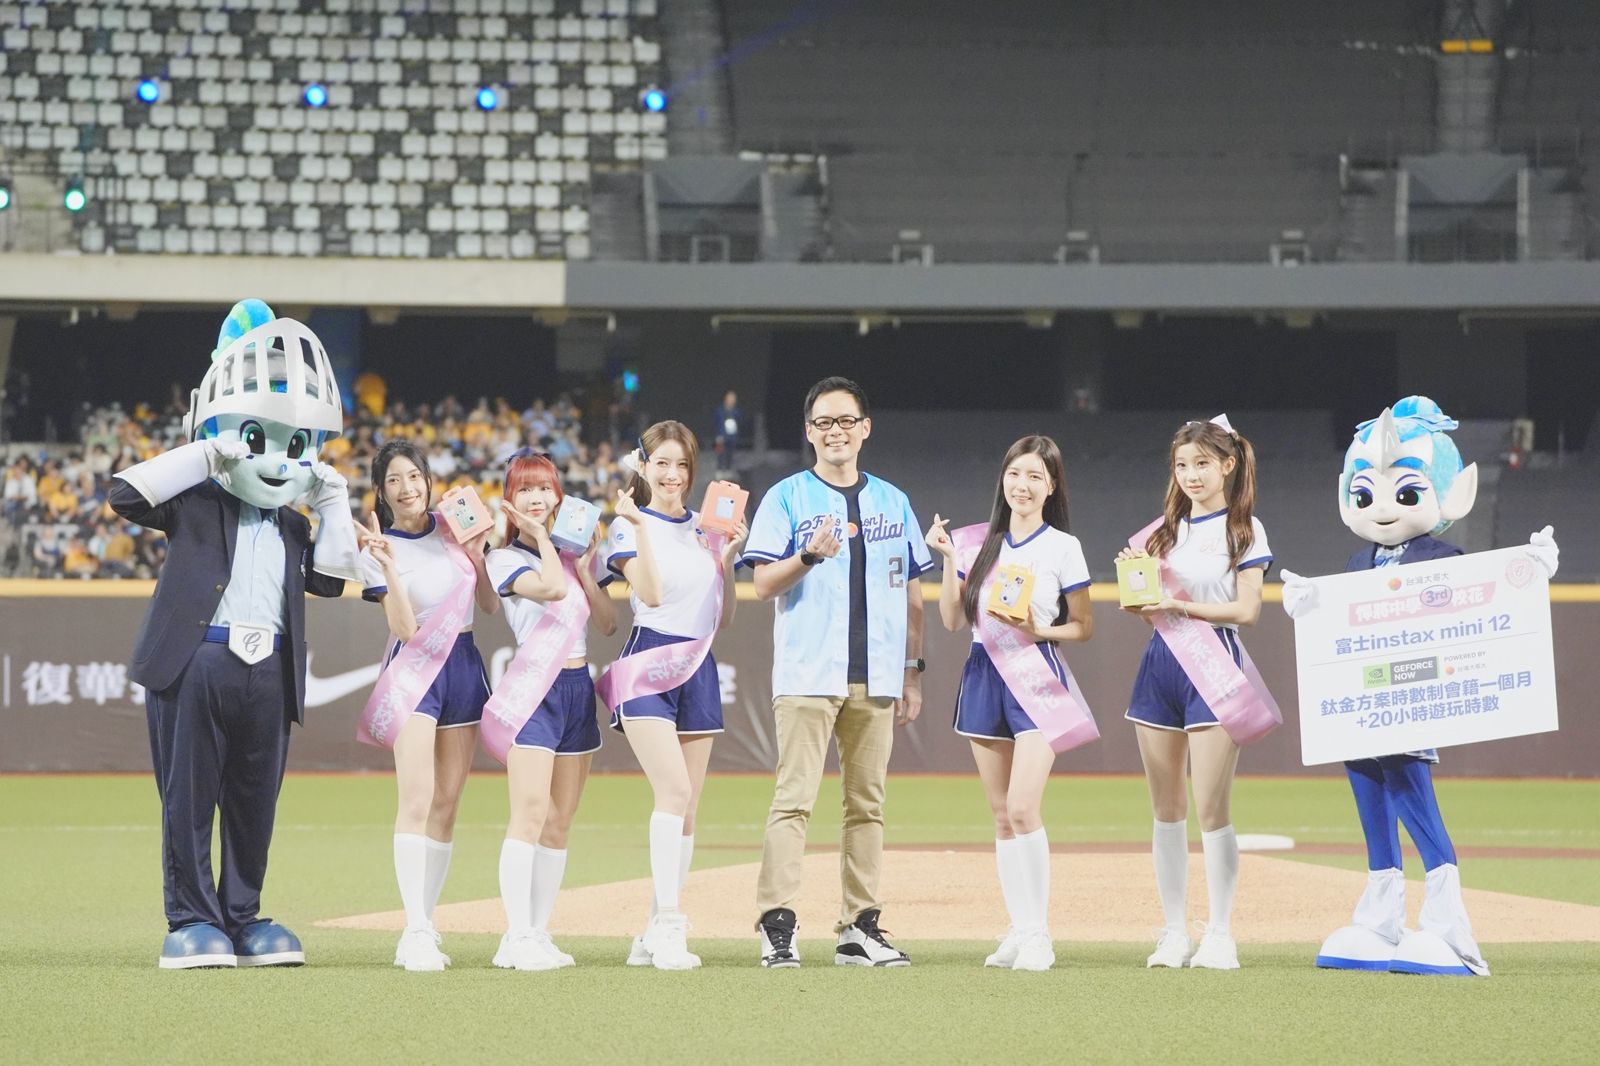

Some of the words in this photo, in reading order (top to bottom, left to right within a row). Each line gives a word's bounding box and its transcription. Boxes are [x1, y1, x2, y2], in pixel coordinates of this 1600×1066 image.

[1406, 571, 1449, 586] 台灣大哥大
[1425, 589, 1448, 603] 3rd
[1440, 619, 1483, 640] mini
[1488, 614, 1511, 632] 12
[1444, 651, 1475, 662] POWERED
[1393, 660, 1434, 674] GEFORCE
[1394, 671, 1416, 681] NOW
[1320, 670, 1532, 717] 鈦金方案時數制會籍一個月
[1356, 694, 1500, 729] +20小時遊玩時數
